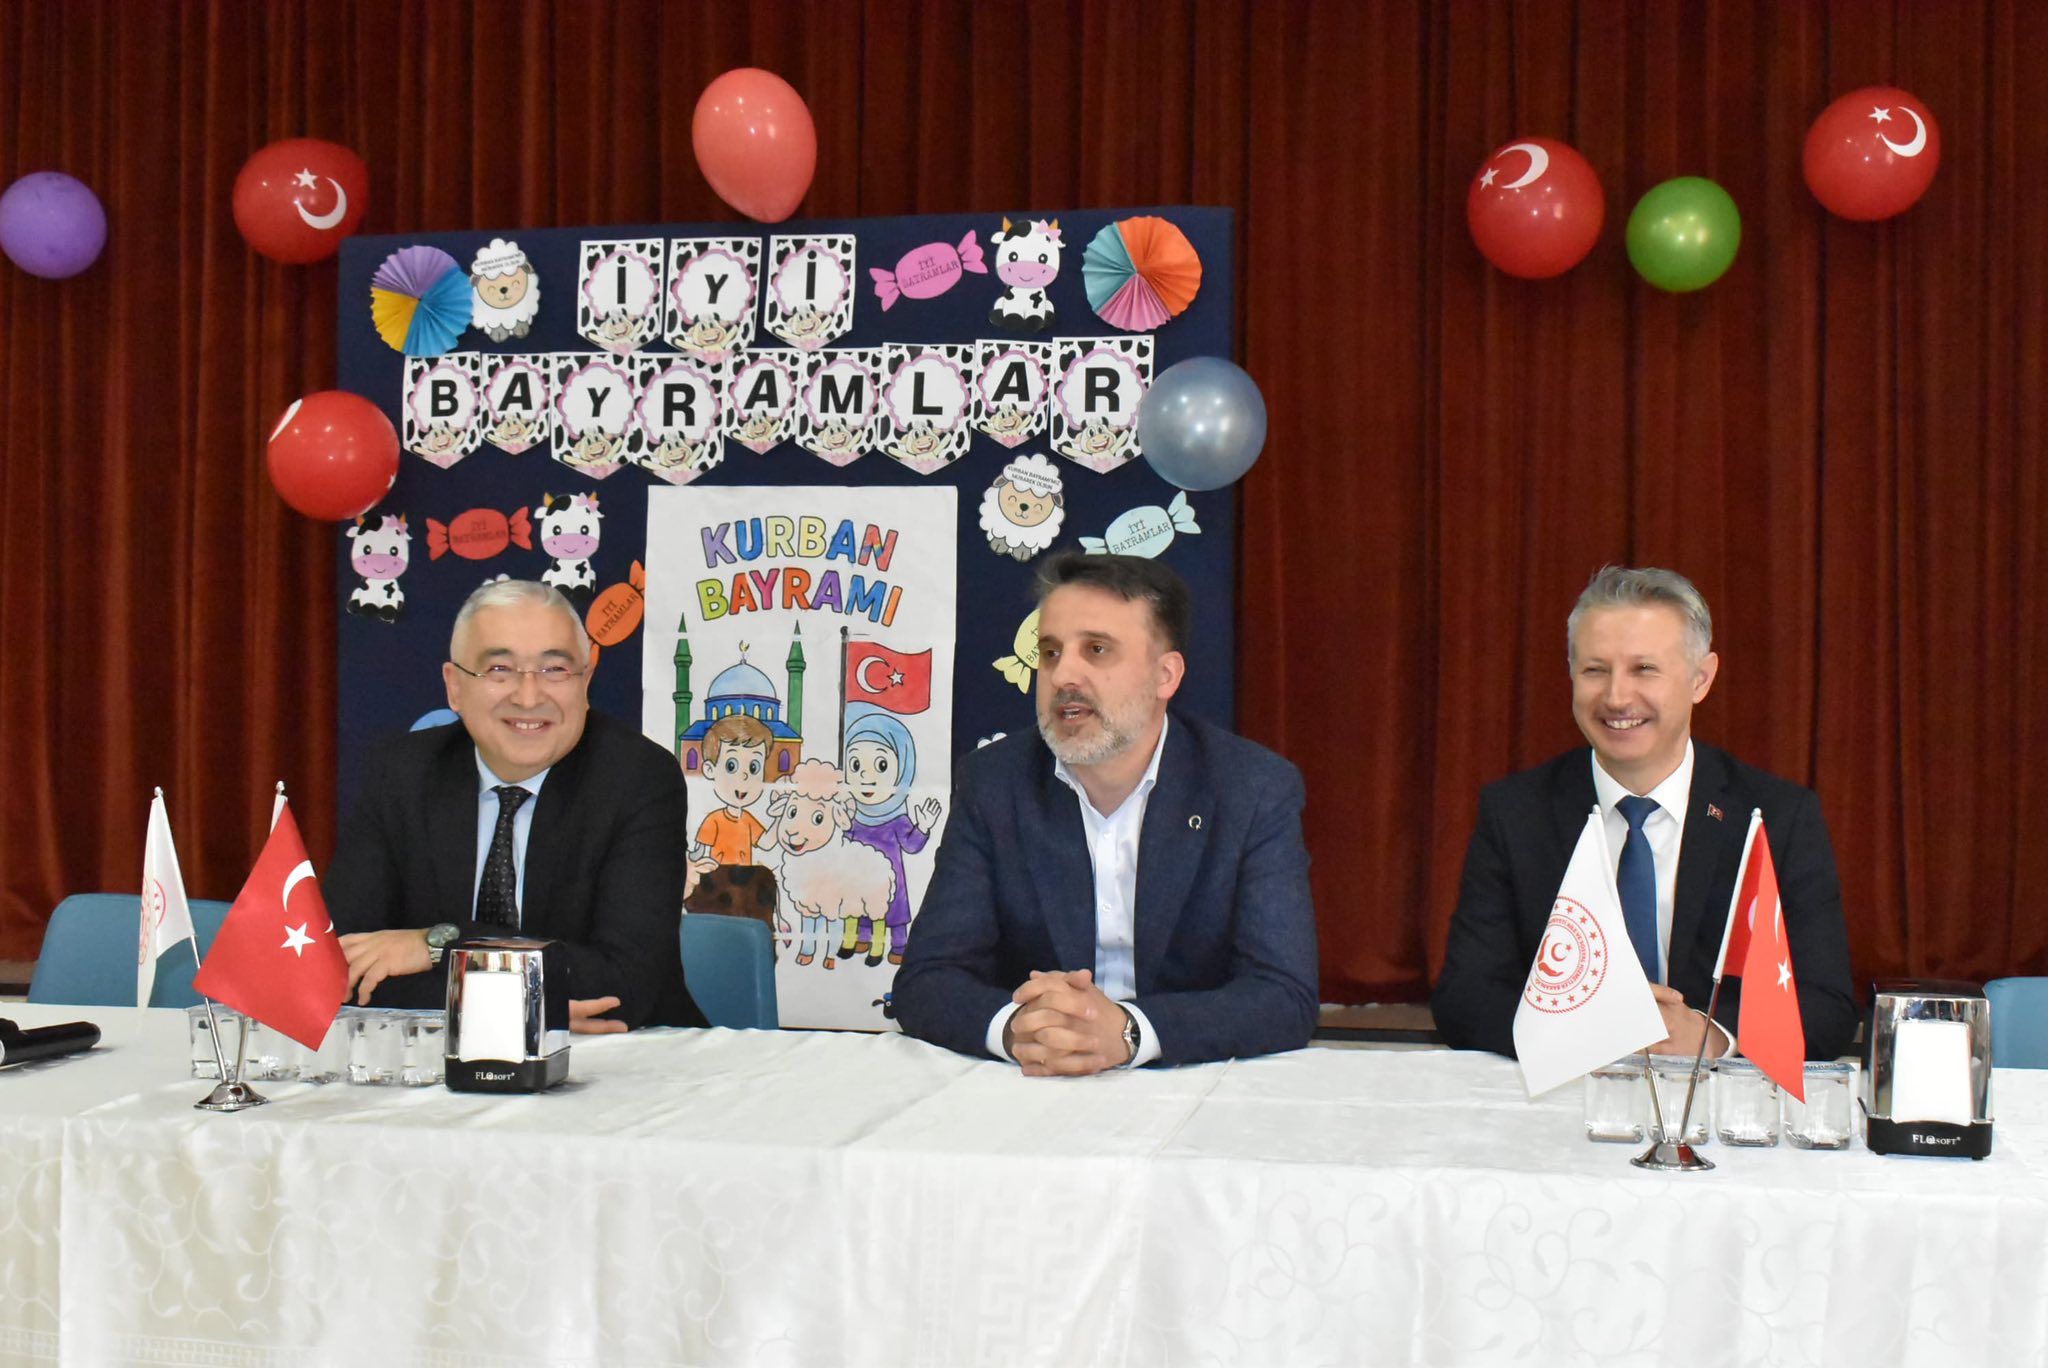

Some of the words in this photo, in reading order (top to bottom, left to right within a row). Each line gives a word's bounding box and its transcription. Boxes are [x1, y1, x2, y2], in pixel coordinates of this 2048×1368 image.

[617, 250, 817, 305] İYİ
[431, 361, 1120, 427] BAYRAMLAR
[701, 515, 899, 572] KURBAN
[1112, 521, 1171, 554] BAYRAMLAR
[696, 567, 903, 627] BAYRAMI
